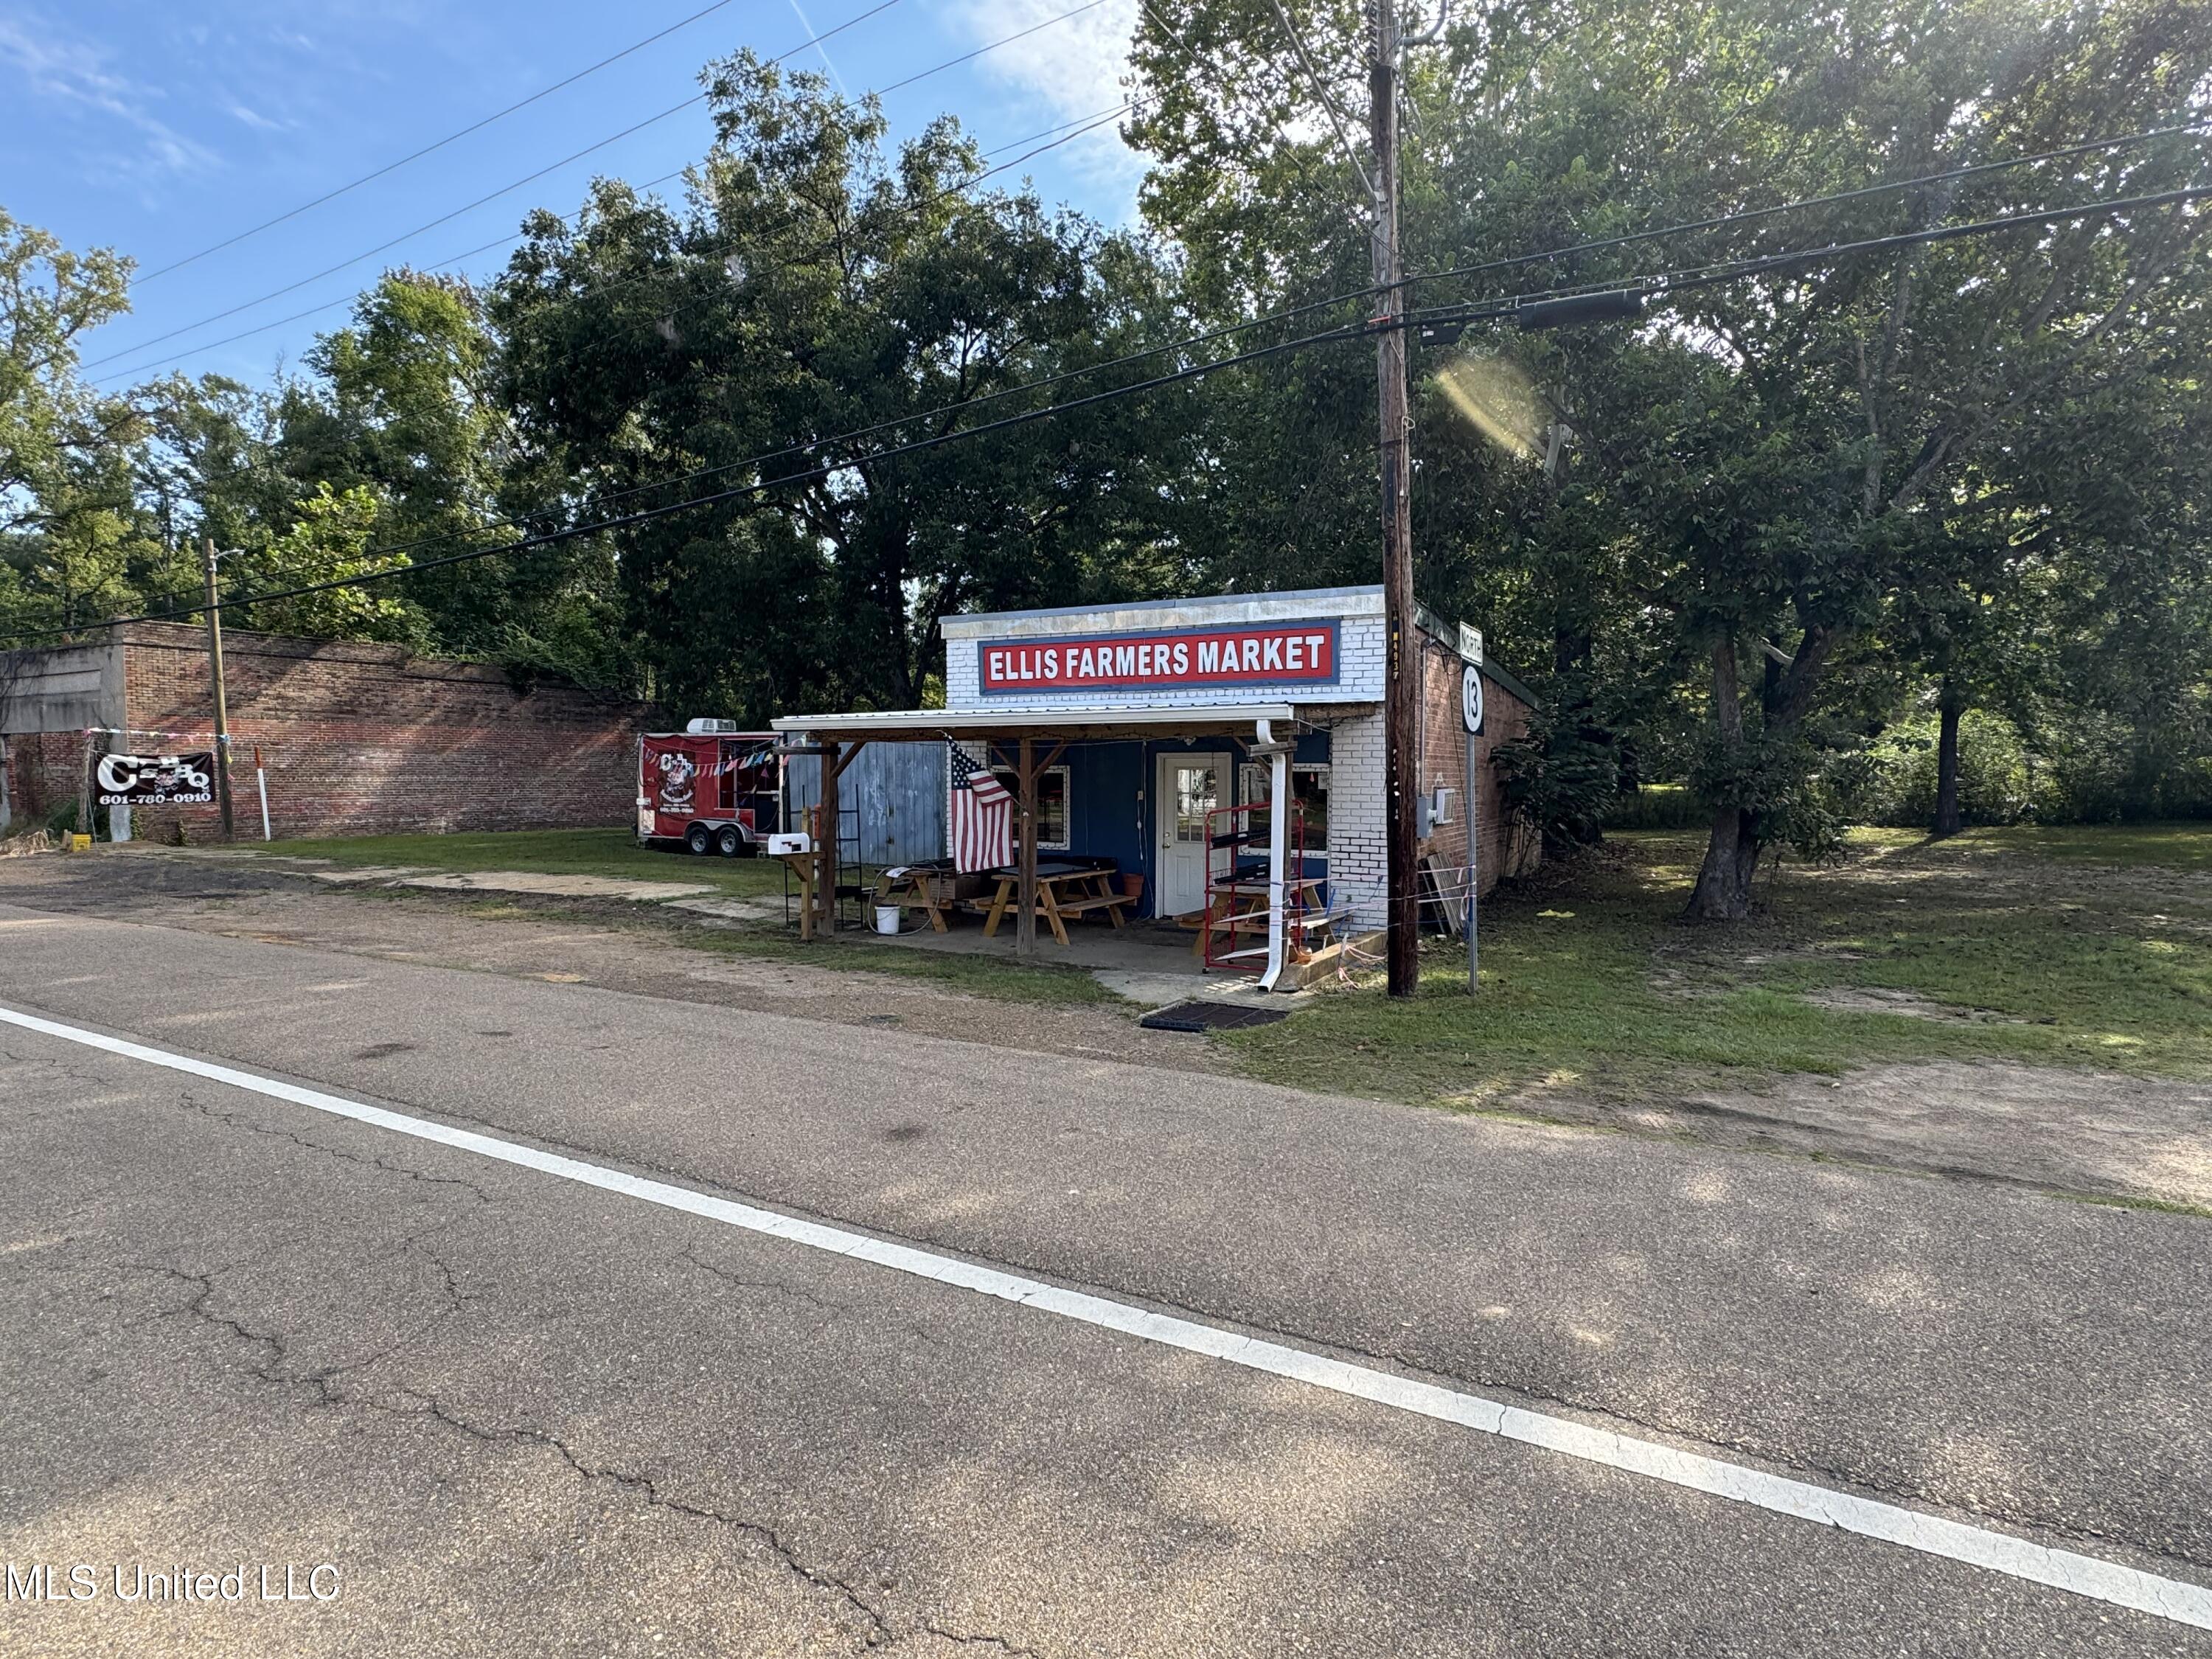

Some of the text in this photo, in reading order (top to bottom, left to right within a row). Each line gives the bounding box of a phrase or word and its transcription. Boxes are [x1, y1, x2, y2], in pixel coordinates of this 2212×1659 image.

[990, 635, 1325, 681] ELLIS FARMERS MARKET
[1461, 630, 1482, 658] NORTH
[1467, 679, 1478, 718] 13
[99, 793, 212, 805] 601-780-0910
